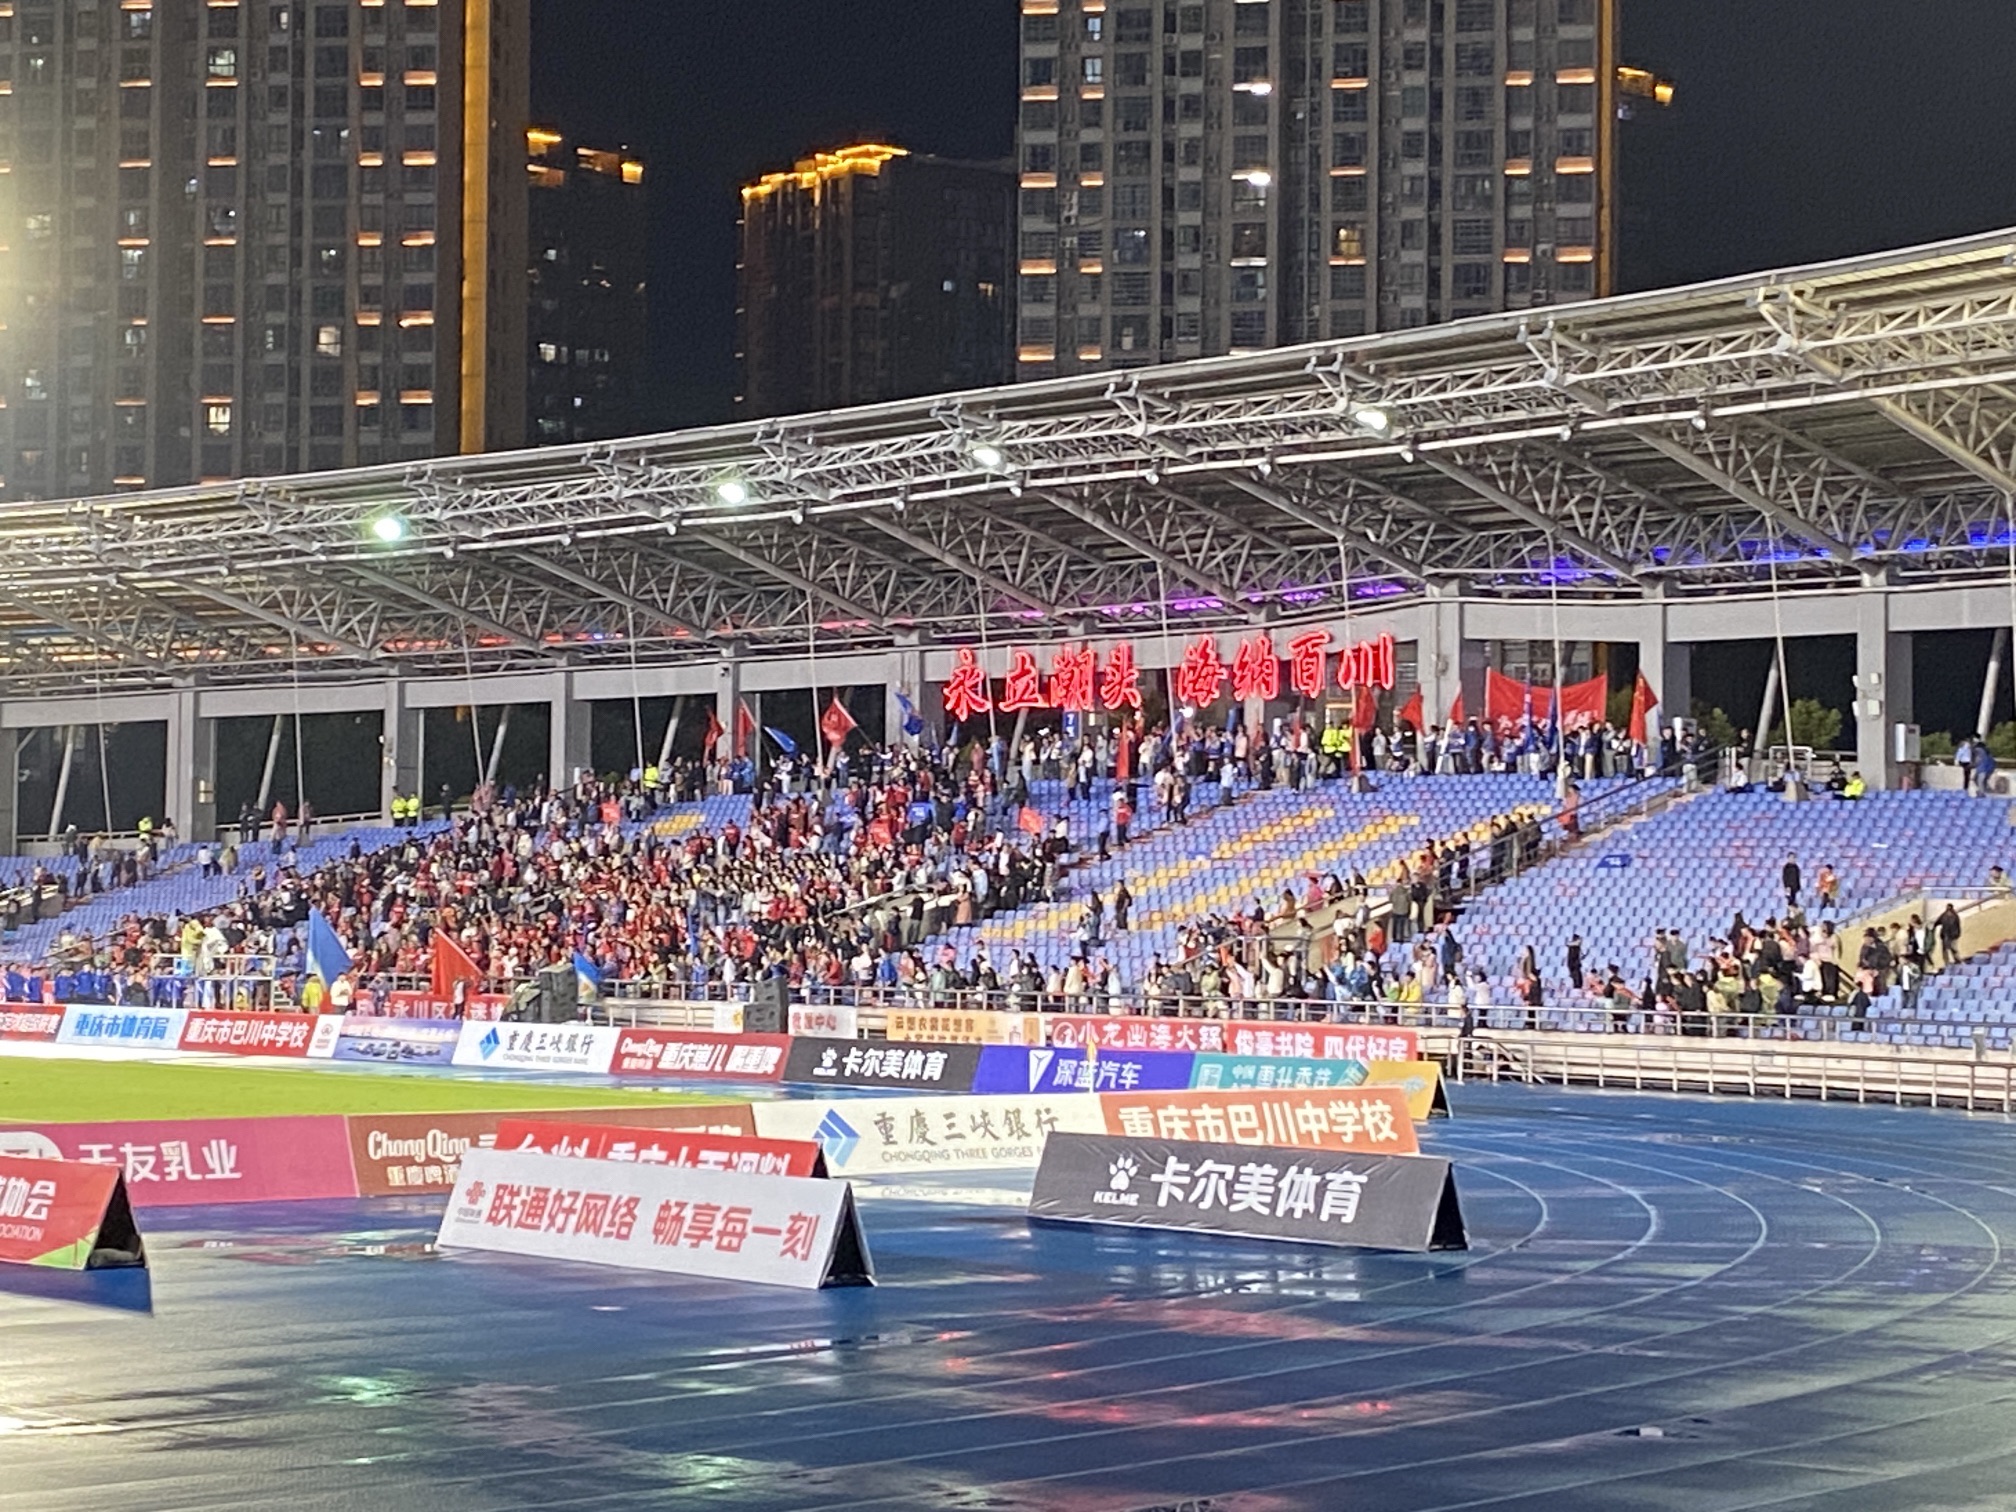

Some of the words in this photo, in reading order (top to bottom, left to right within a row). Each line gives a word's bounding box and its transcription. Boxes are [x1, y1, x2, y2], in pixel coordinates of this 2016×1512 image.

[943, 647, 1142, 721] 永立潮头
[1177, 630, 1394, 707] 海纳百川
[74, 1013, 170, 1040] 重庆市体育局
[185, 1017, 309, 1048] 重庆市巴川中学校
[842, 1046, 948, 1081] 卡尔美体育
[1052, 1058, 1143, 1090] 深蓝汽车
[1117, 1098, 1398, 1146] 重庆市巴川中学校
[368, 1129, 470, 1163] ChongQing
[881, 1149, 950, 1164] CHONGQING
[954, 1147, 988, 1161] THREE
[992, 1146, 1033, 1159] GORGES
[0, 1174, 56, 1221] 协会
[1093, 1190, 1140, 1206] KELME
[1151, 1156, 1367, 1223] 卡尔美体育
[486, 1182, 640, 1241] 联通好网络
[651, 1199, 821, 1262] 畅享每一刻
